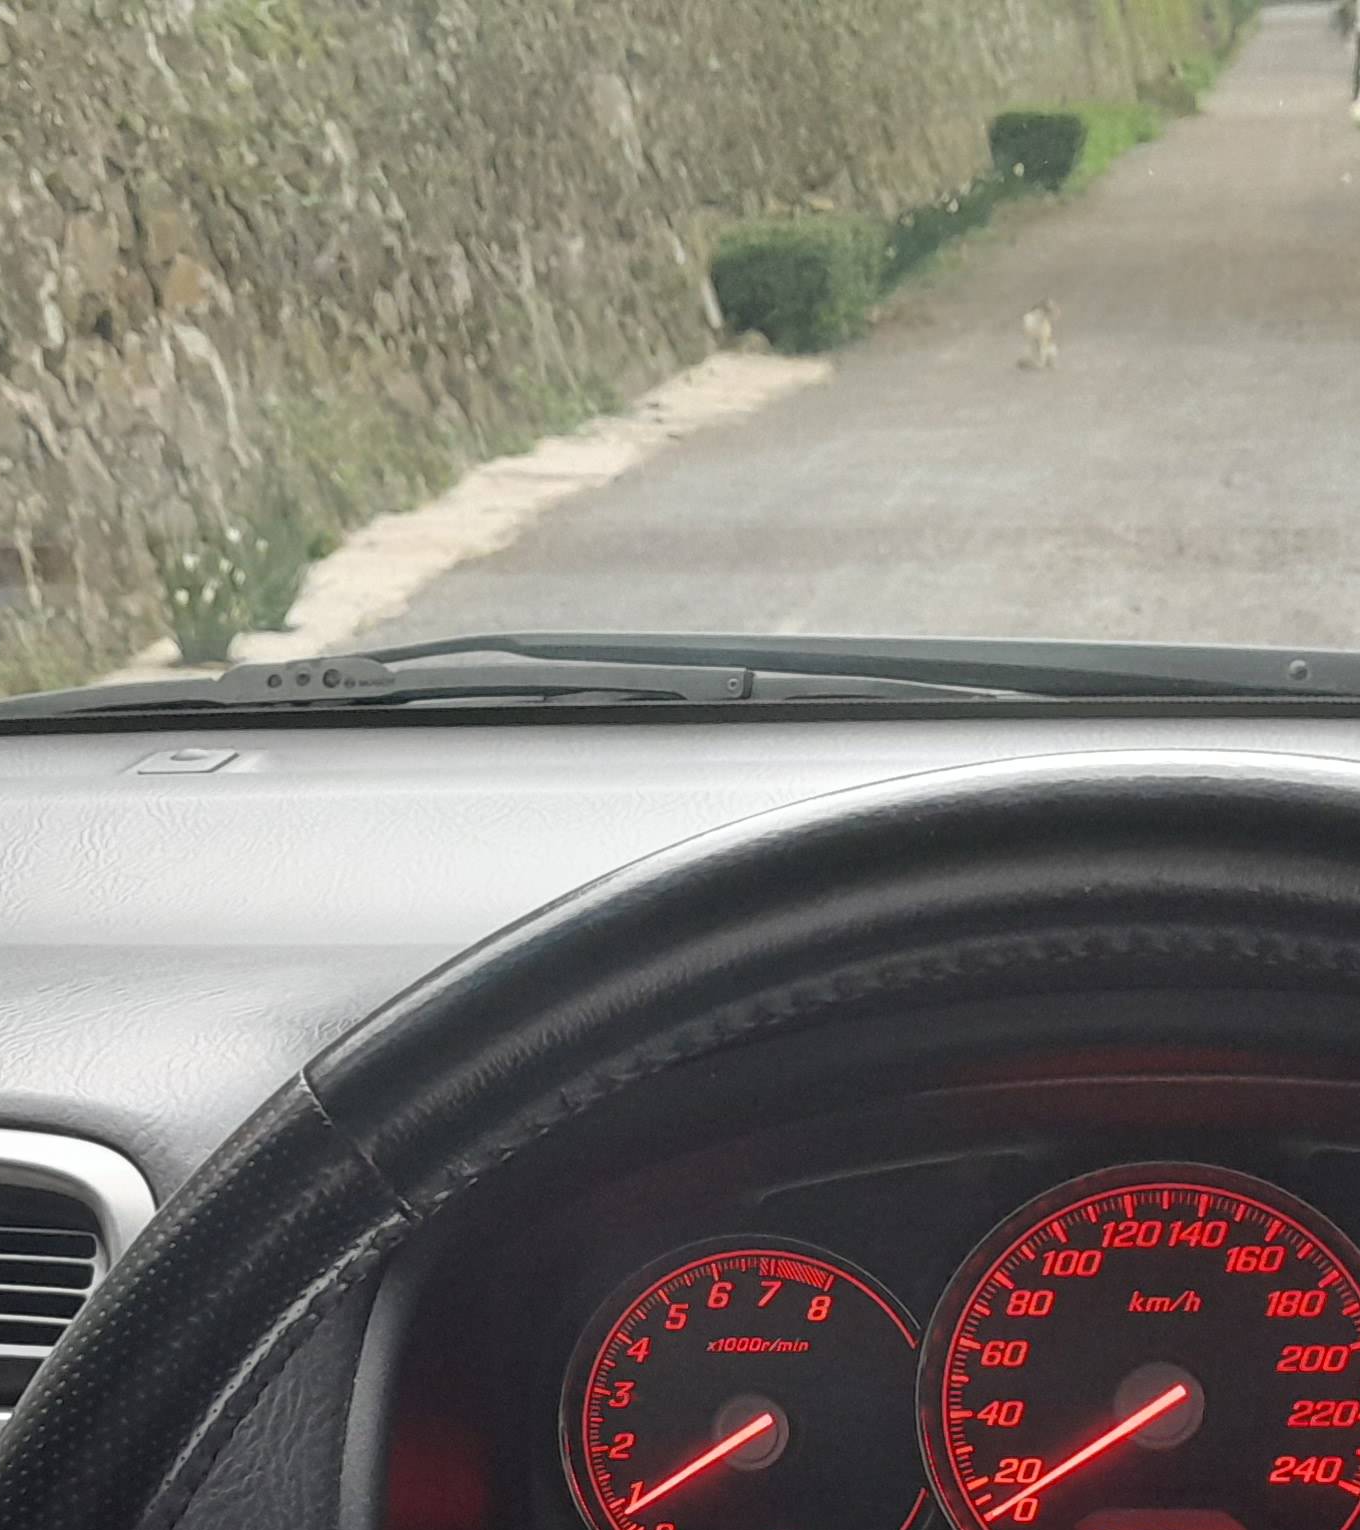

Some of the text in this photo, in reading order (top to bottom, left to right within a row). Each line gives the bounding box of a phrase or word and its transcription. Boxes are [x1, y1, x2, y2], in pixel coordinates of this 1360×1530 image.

[1101, 1219, 1162, 1248] 120
[1168, 1219, 1229, 1250] 140
[1040, 1249, 1102, 1277] 100
[1224, 1246, 1285, 1274] 160
[706, 1280, 734, 1309] 6
[757, 1279, 783, 1308] 7
[1006, 1289, 1054, 1317] 80
[1128, 1288, 1201, 1315] km/h
[1265, 1289, 1326, 1318] 180
[663, 1302, 690, 1330] 5
[806, 1294, 833, 1322] 8
[625, 1336, 652, 1364] 4
[705, 1336, 810, 1354] x1000r/min
[980, 1340, 1029, 1368] 60
[1275, 1344, 1349, 1373] 200
[607, 1380, 636, 1409] 3
[976, 1400, 1024, 1428] 40
[1287, 1400, 1357, 1429] 220
[607, 1431, 636, 1461] 2
[993, 1458, 1042, 1484] 20
[1269, 1456, 1342, 1485] 240
[628, 1480, 644, 1505] 1
[1012, 1497, 1039, 1522] 0
